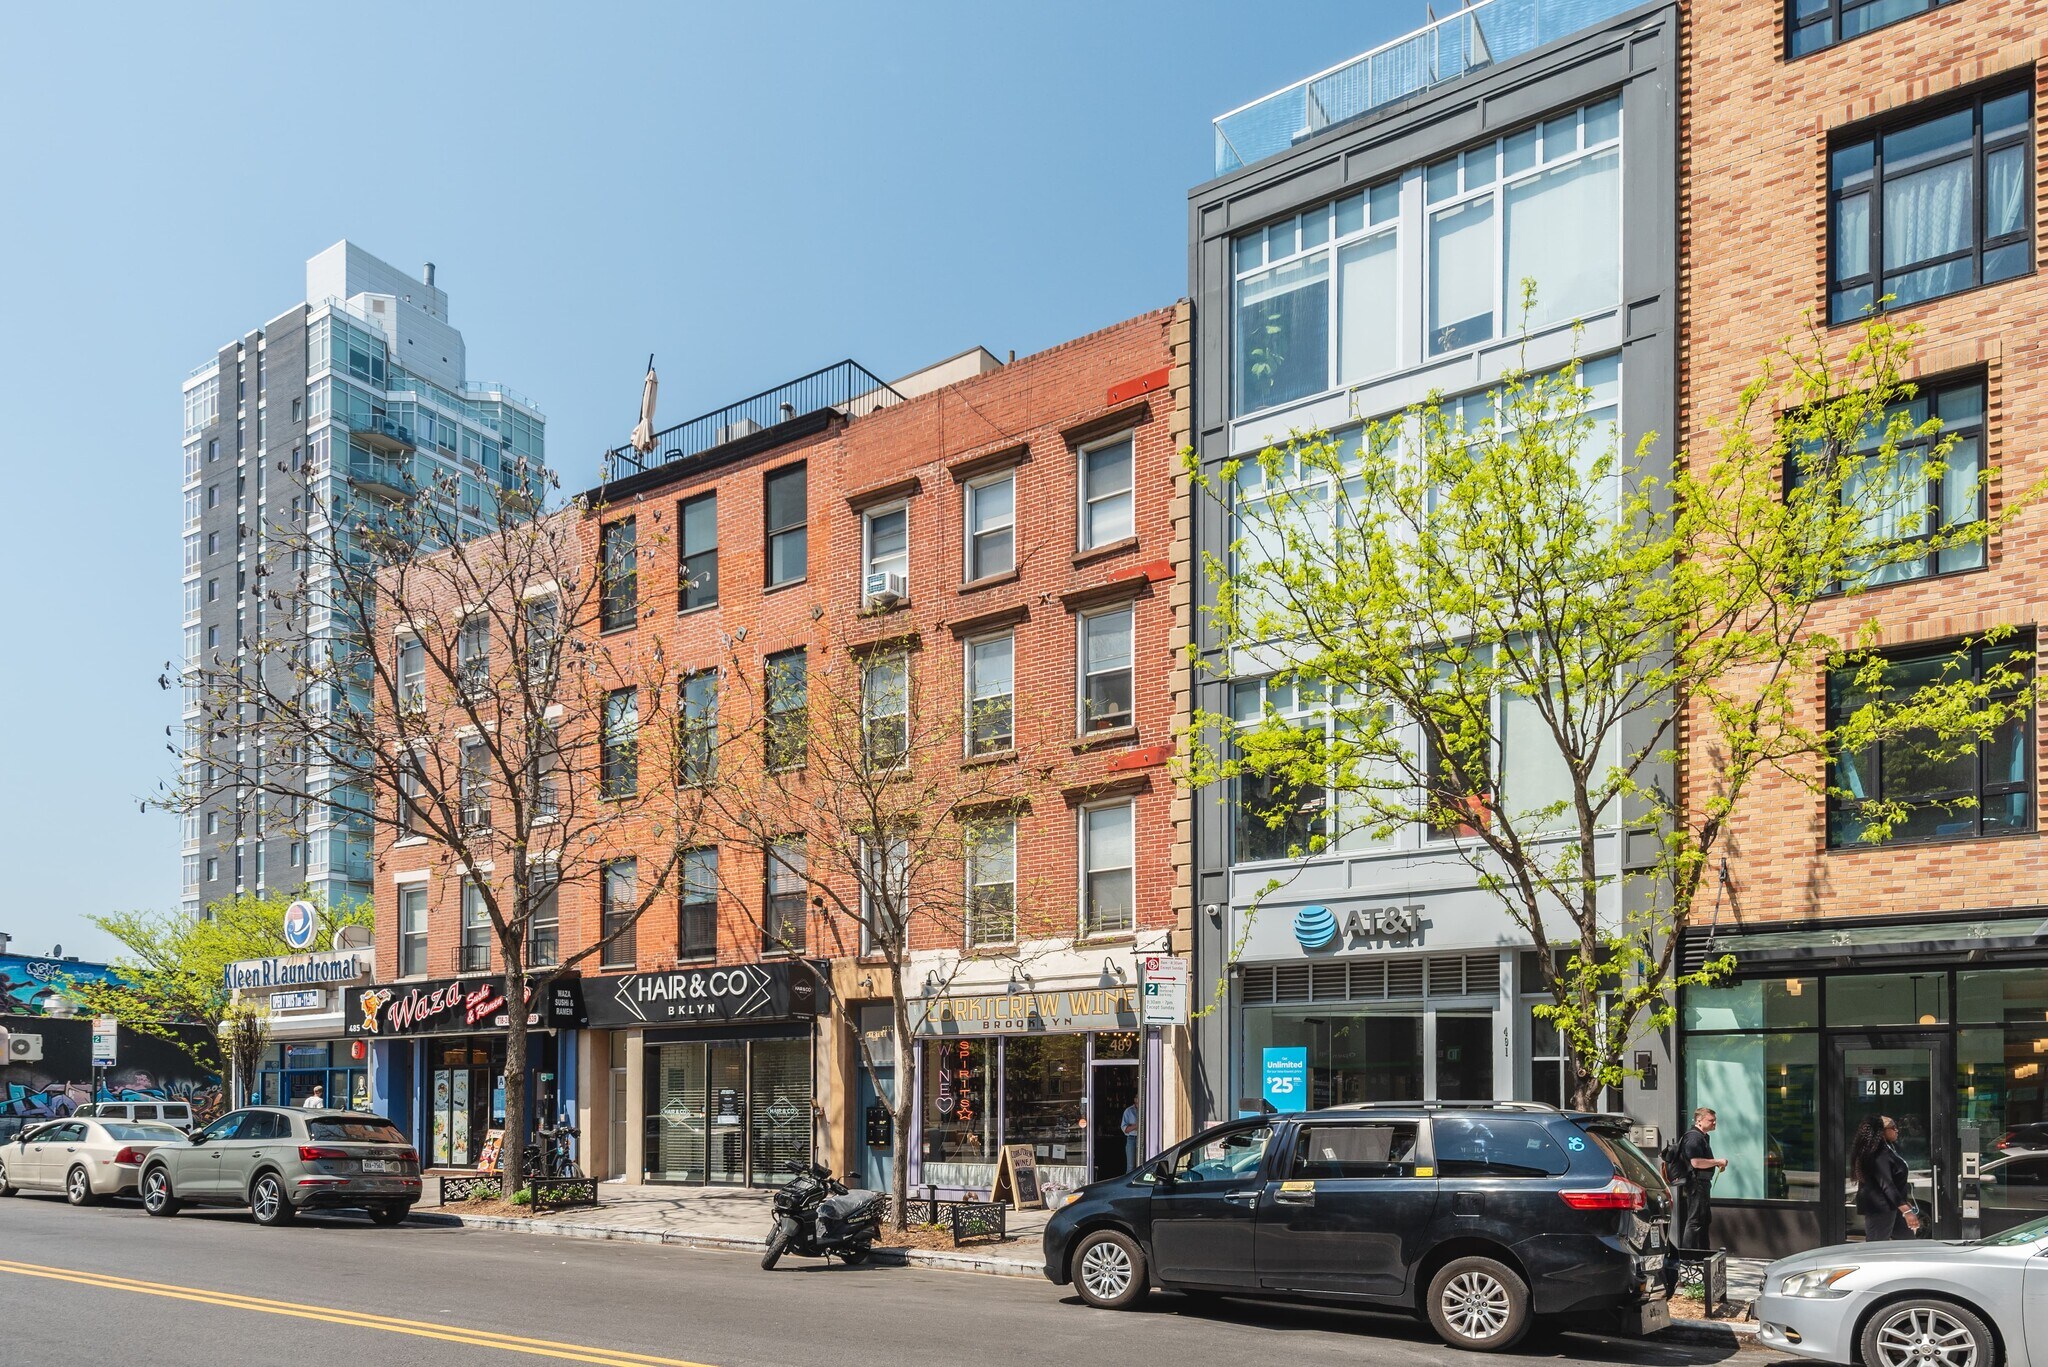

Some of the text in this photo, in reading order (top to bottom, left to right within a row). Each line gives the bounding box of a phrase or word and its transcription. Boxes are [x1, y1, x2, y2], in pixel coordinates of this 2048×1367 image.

[1342, 904, 1426, 937] AT&T
[224, 963, 260, 989] Kleen
[273, 956, 358, 986] Laundromat
[466, 984, 490, 1009] Sushi
[1148, 984, 1156, 995] 2
[388, 981, 462, 1032] Waza
[467, 995, 504, 1024] & Ramen
[668, 1003, 715, 1016] BKLYN
[1068, 988, 1140, 1016] WINE
[349, 1024, 360, 1033] 485
[983, 1017, 1072, 1029] BROOKLYN
[1110, 1039, 1132, 1053] 489
[937, 1043, 952, 1096] WINE
[959, 1041, 971, 1108] SPIRITS
[1266, 1076, 1294, 1094] $25
[1867, 1081, 1902, 1094] 493
[1014, 1159, 1033, 1167] WINES
